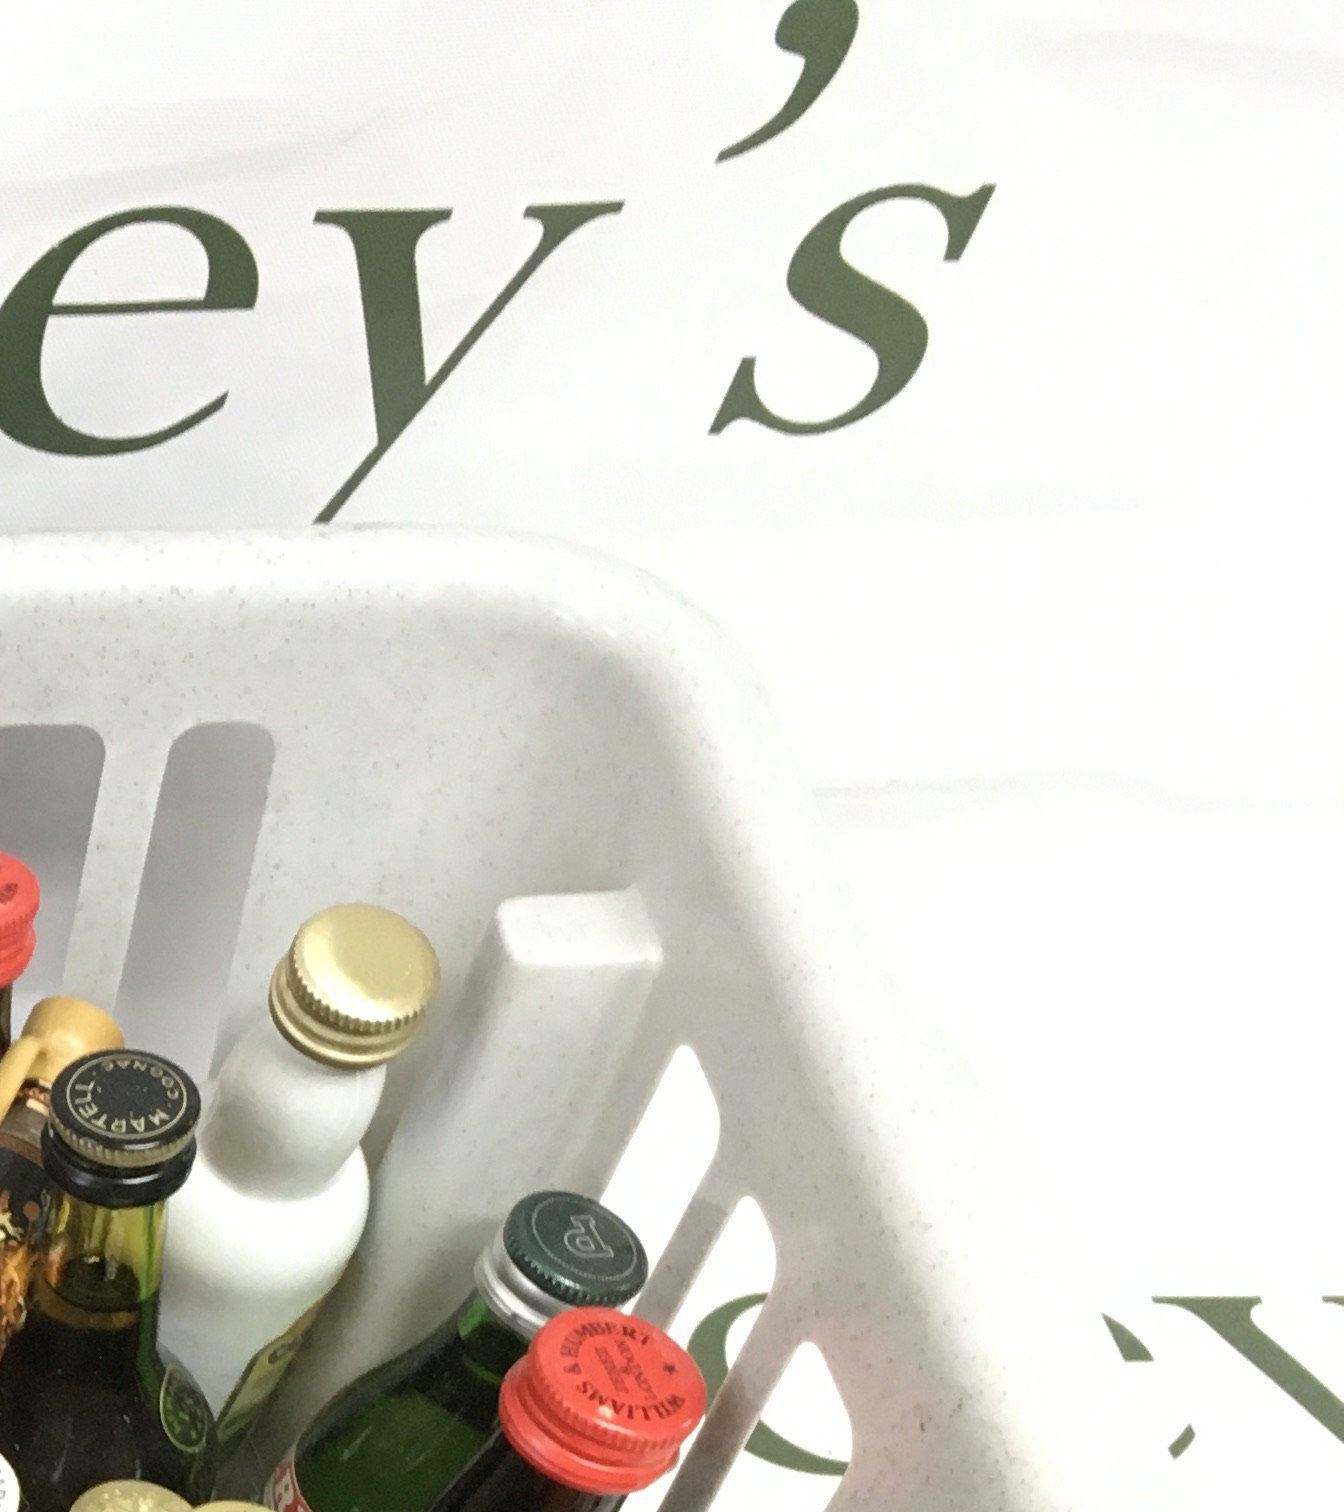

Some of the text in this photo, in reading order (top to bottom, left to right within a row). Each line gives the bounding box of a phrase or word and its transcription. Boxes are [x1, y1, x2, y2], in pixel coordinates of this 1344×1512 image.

[101, 1060, 179, 1100] COGNAC
[75, 1079, 171, 1133] MARTELL
[560, 1321, 654, 1358] HUMBERT
[576, 1380, 687, 1422] WILLIAMS
